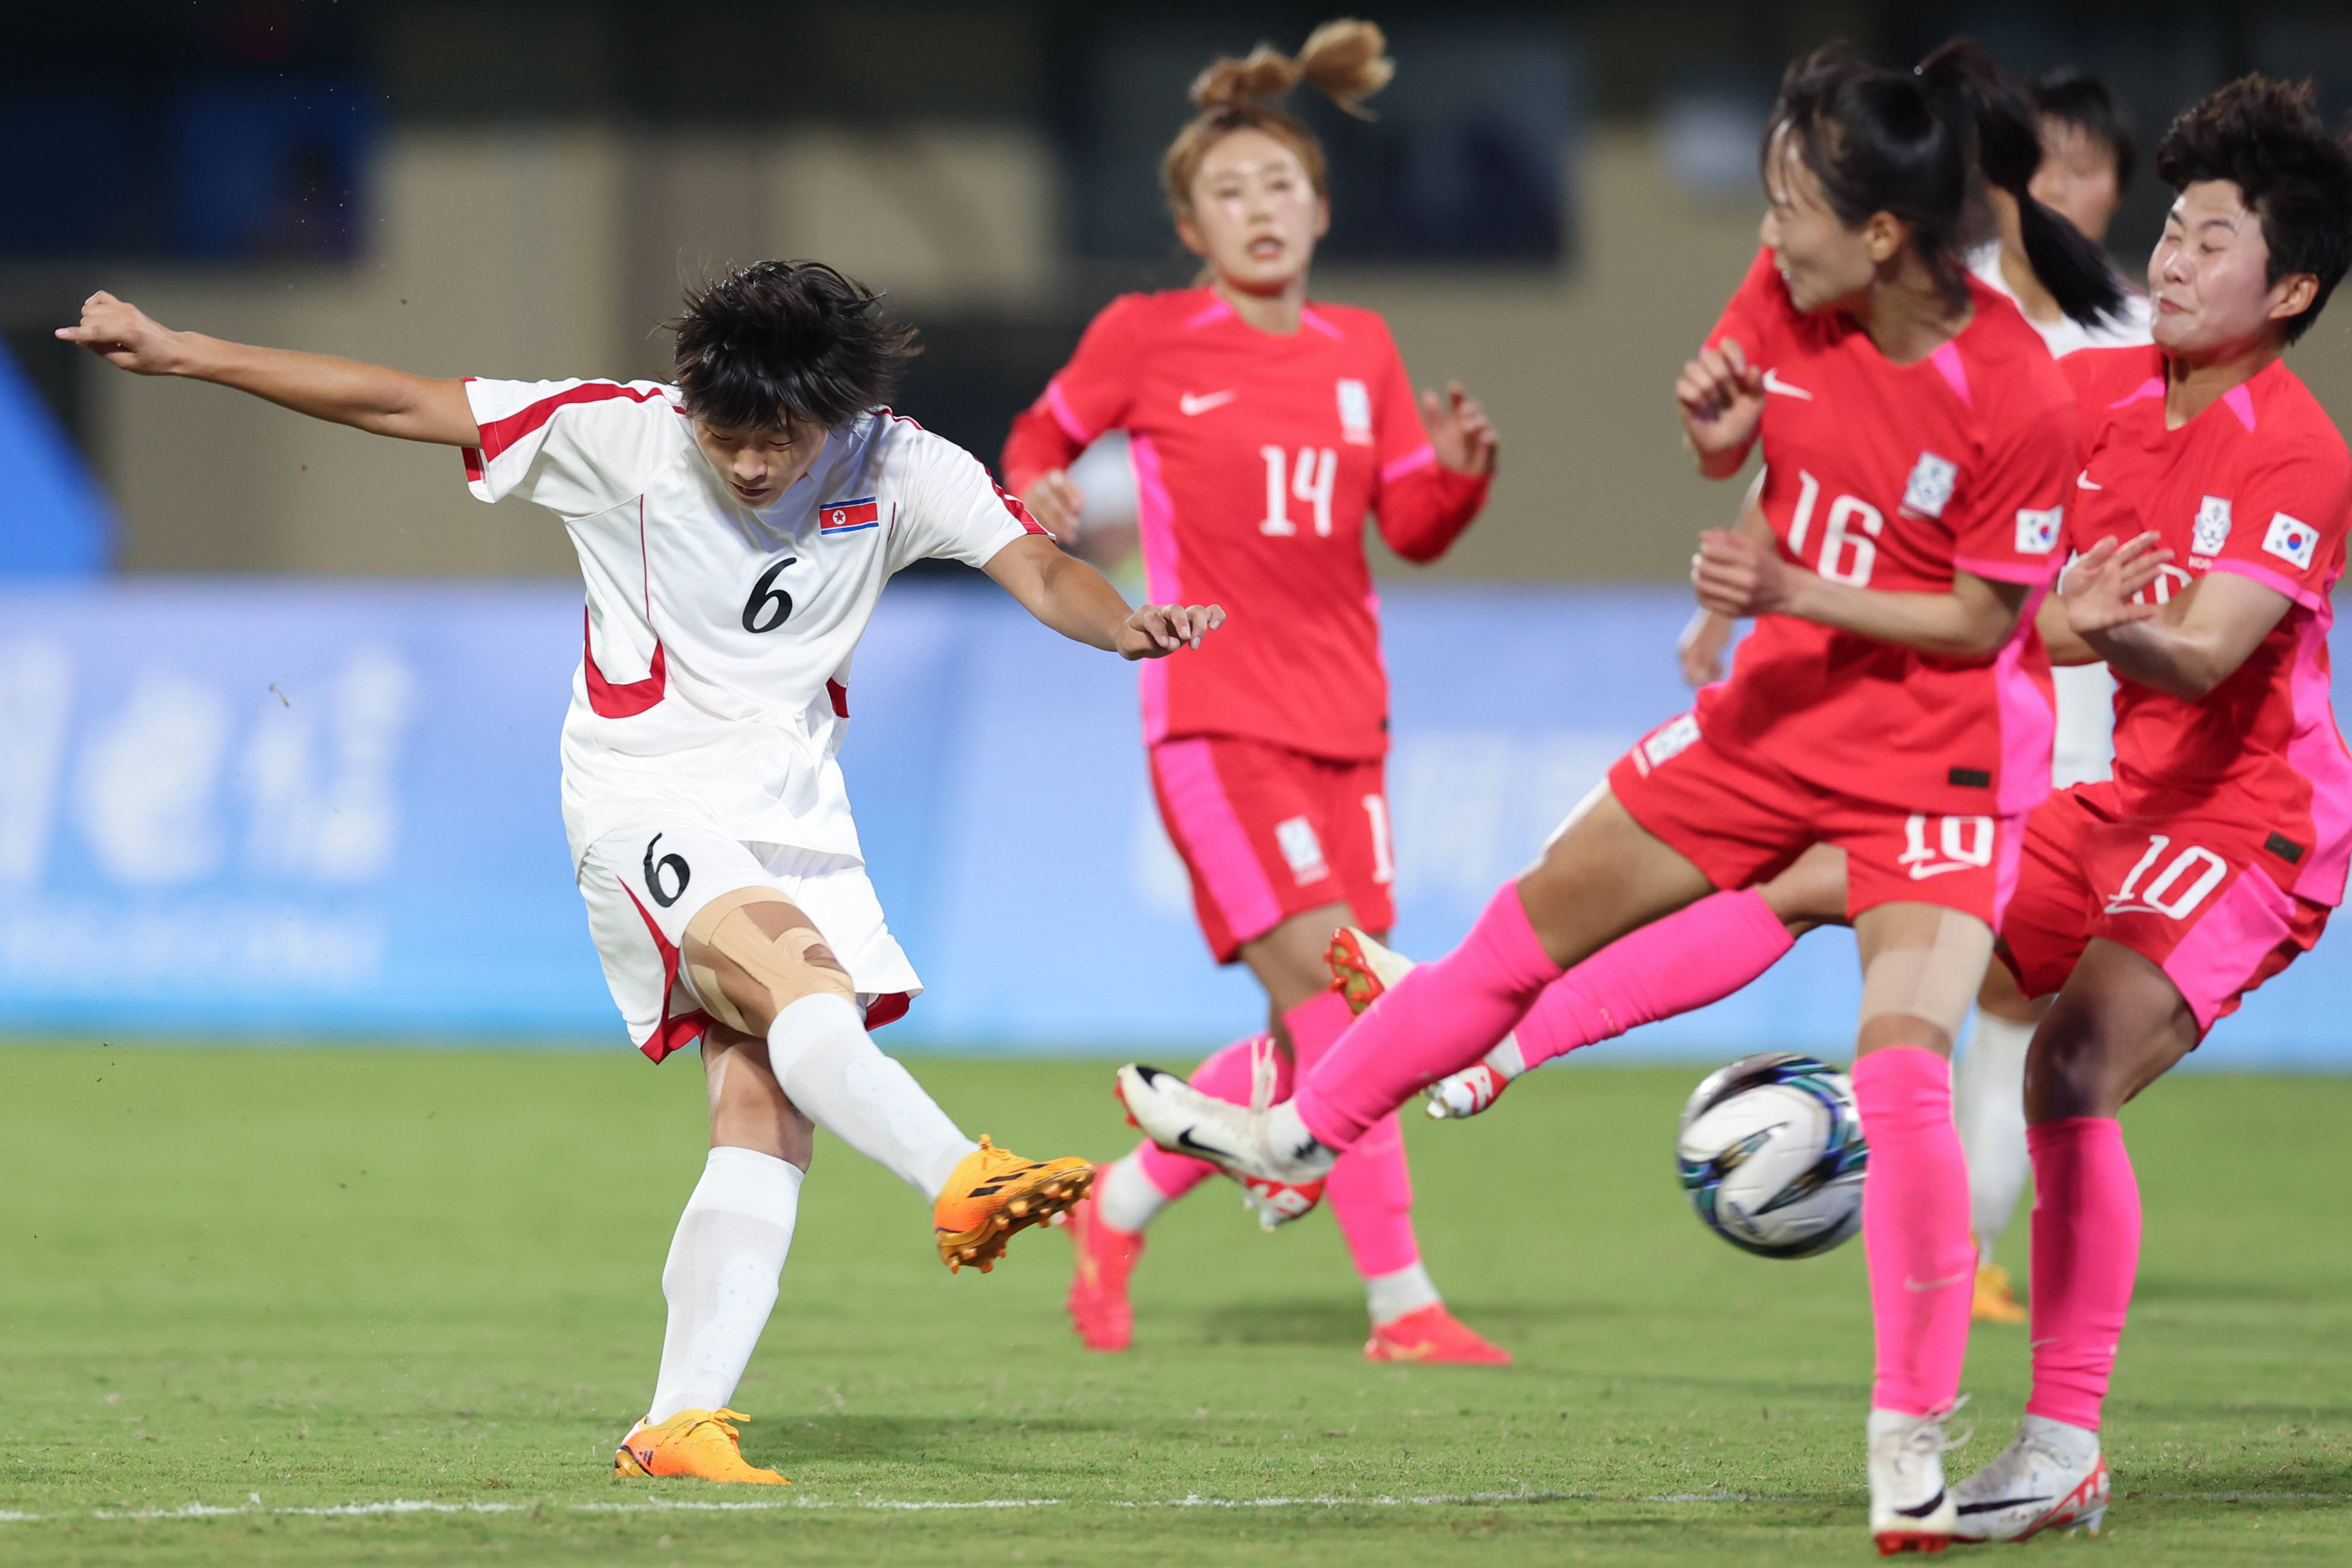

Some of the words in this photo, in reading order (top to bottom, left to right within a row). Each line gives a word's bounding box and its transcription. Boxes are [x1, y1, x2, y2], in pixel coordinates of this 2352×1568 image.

[1259, 445, 1337, 537] 14
[1787, 469, 1884, 589] 16
[742, 557, 797, 633] 6
[643, 832, 691, 908] 6
[2108, 835, 2227, 920] 10
